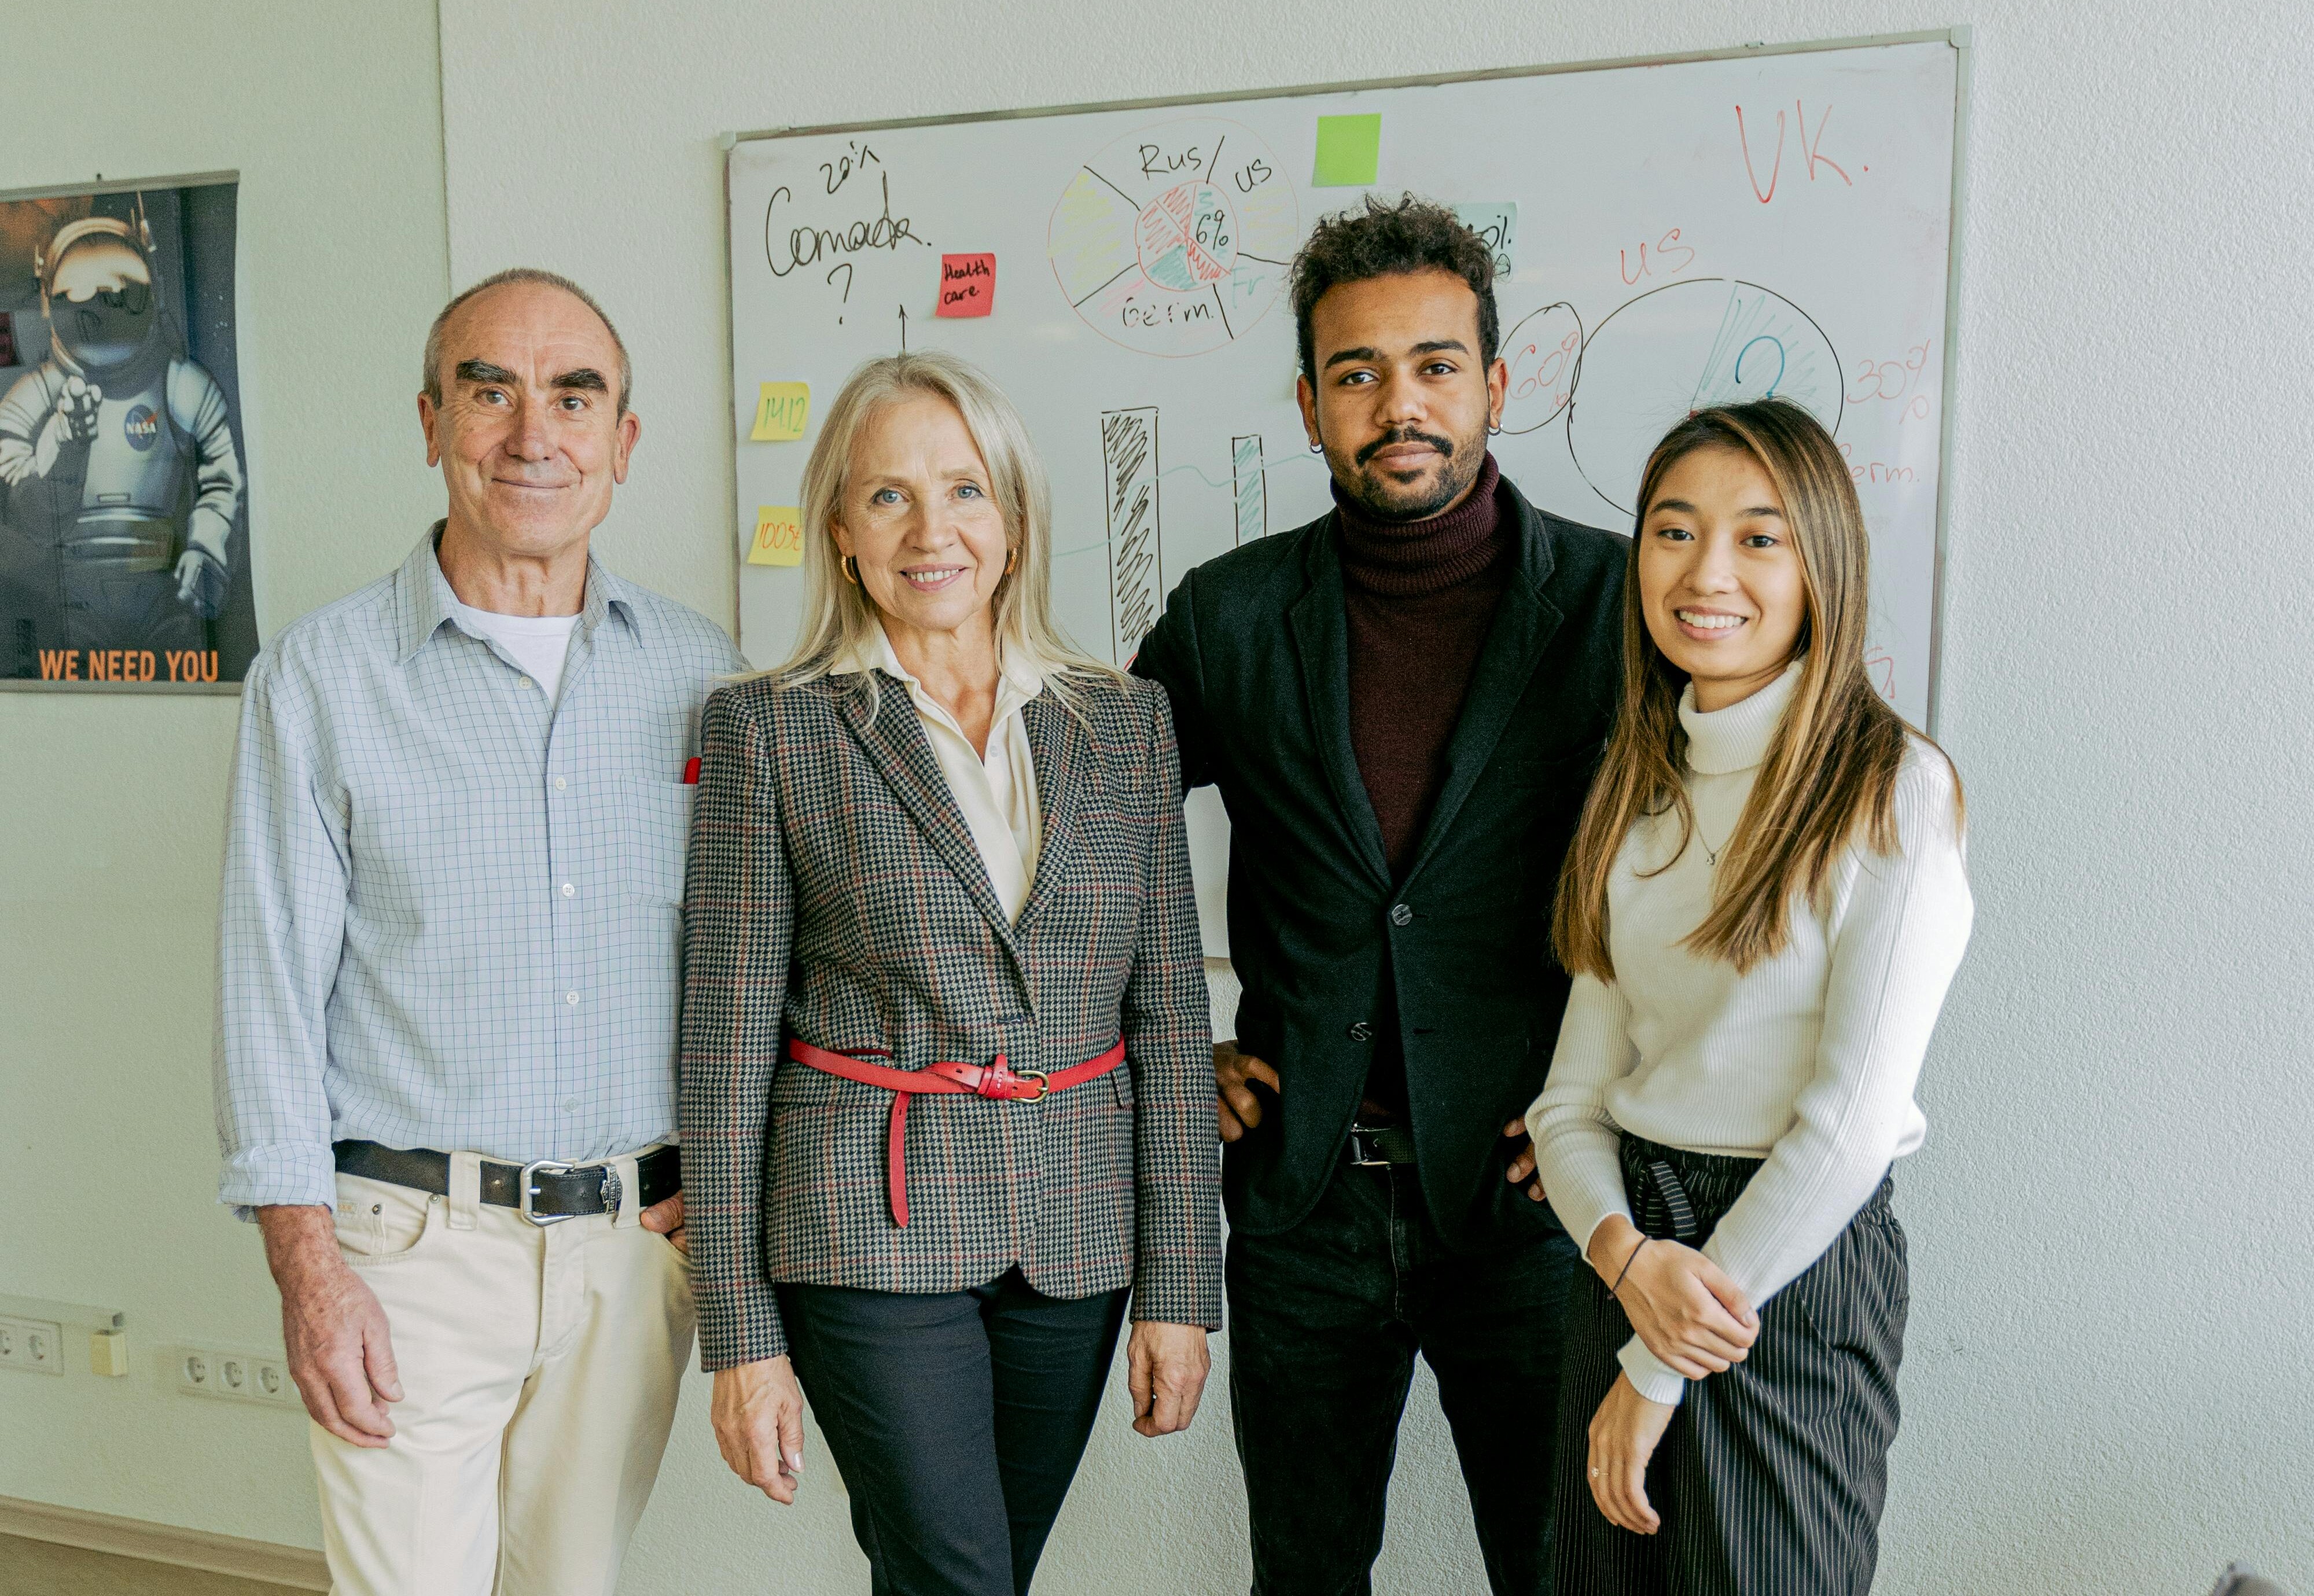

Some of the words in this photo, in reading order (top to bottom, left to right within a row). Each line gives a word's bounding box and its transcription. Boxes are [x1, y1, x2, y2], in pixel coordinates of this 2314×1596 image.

[126, 421, 157, 434] NASA
[39, 649, 80, 681] WE
[89, 649, 156, 682] NEED
[165, 650, 219, 682] YOU
